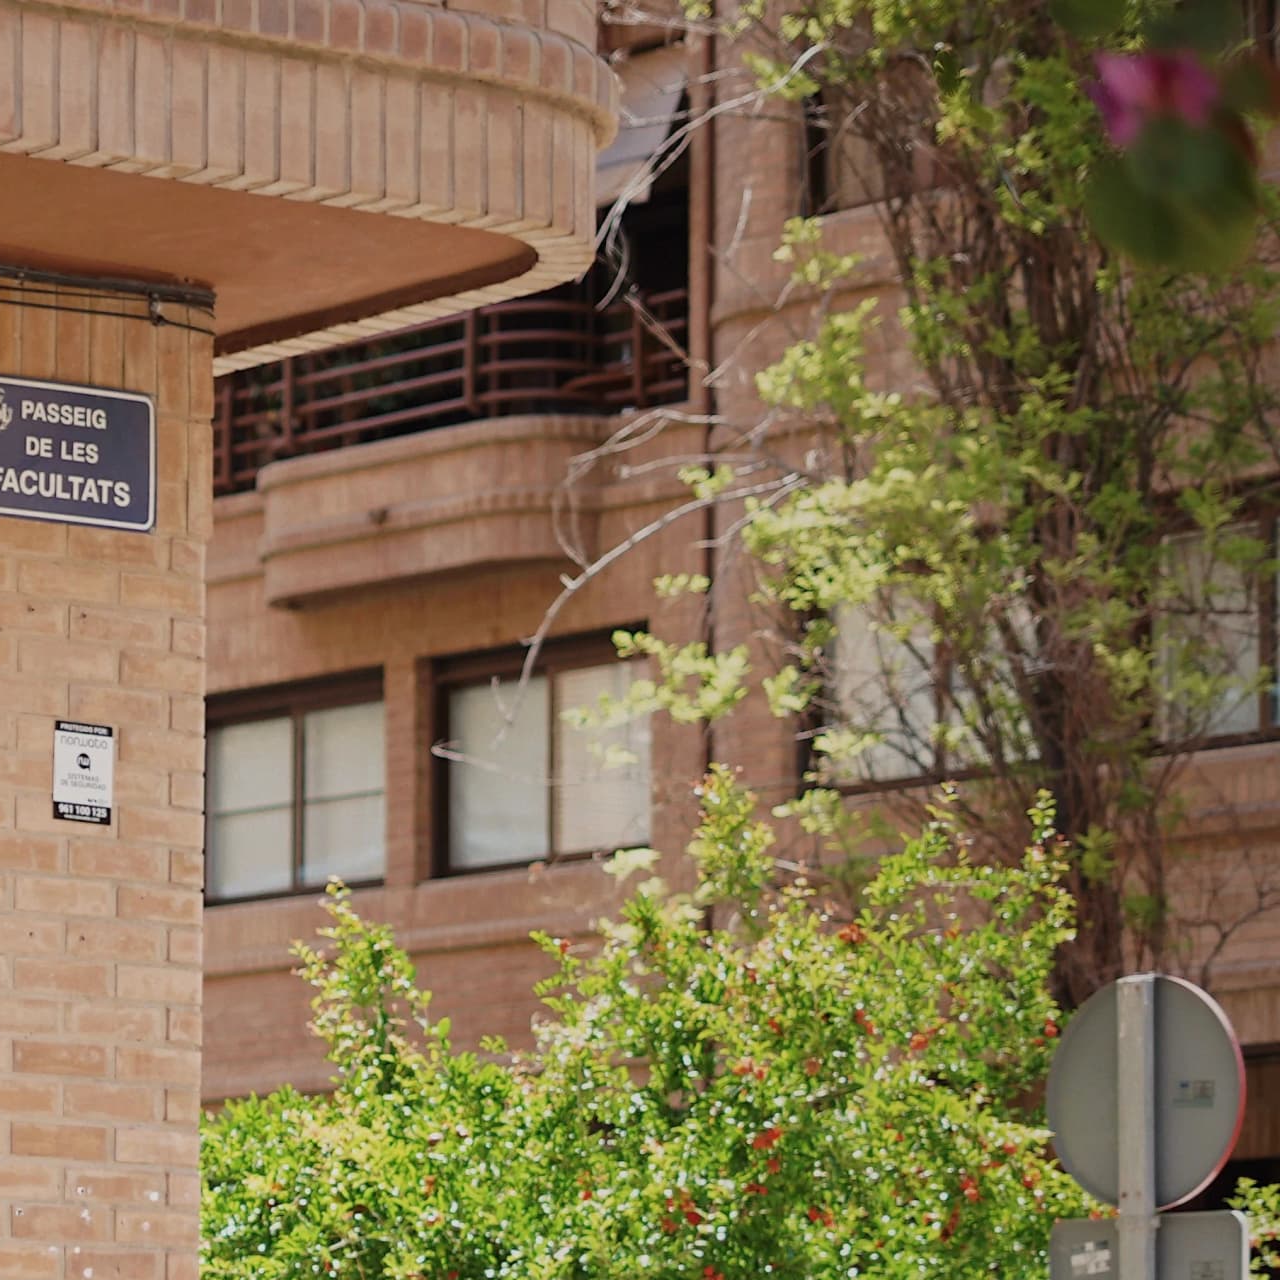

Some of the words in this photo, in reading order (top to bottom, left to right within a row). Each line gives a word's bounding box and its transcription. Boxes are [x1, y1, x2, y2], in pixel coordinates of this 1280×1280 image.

[21, 400, 107, 429] PASSEIG
[25, 436, 53, 458] DE
[61, 440, 99, 464] LES
